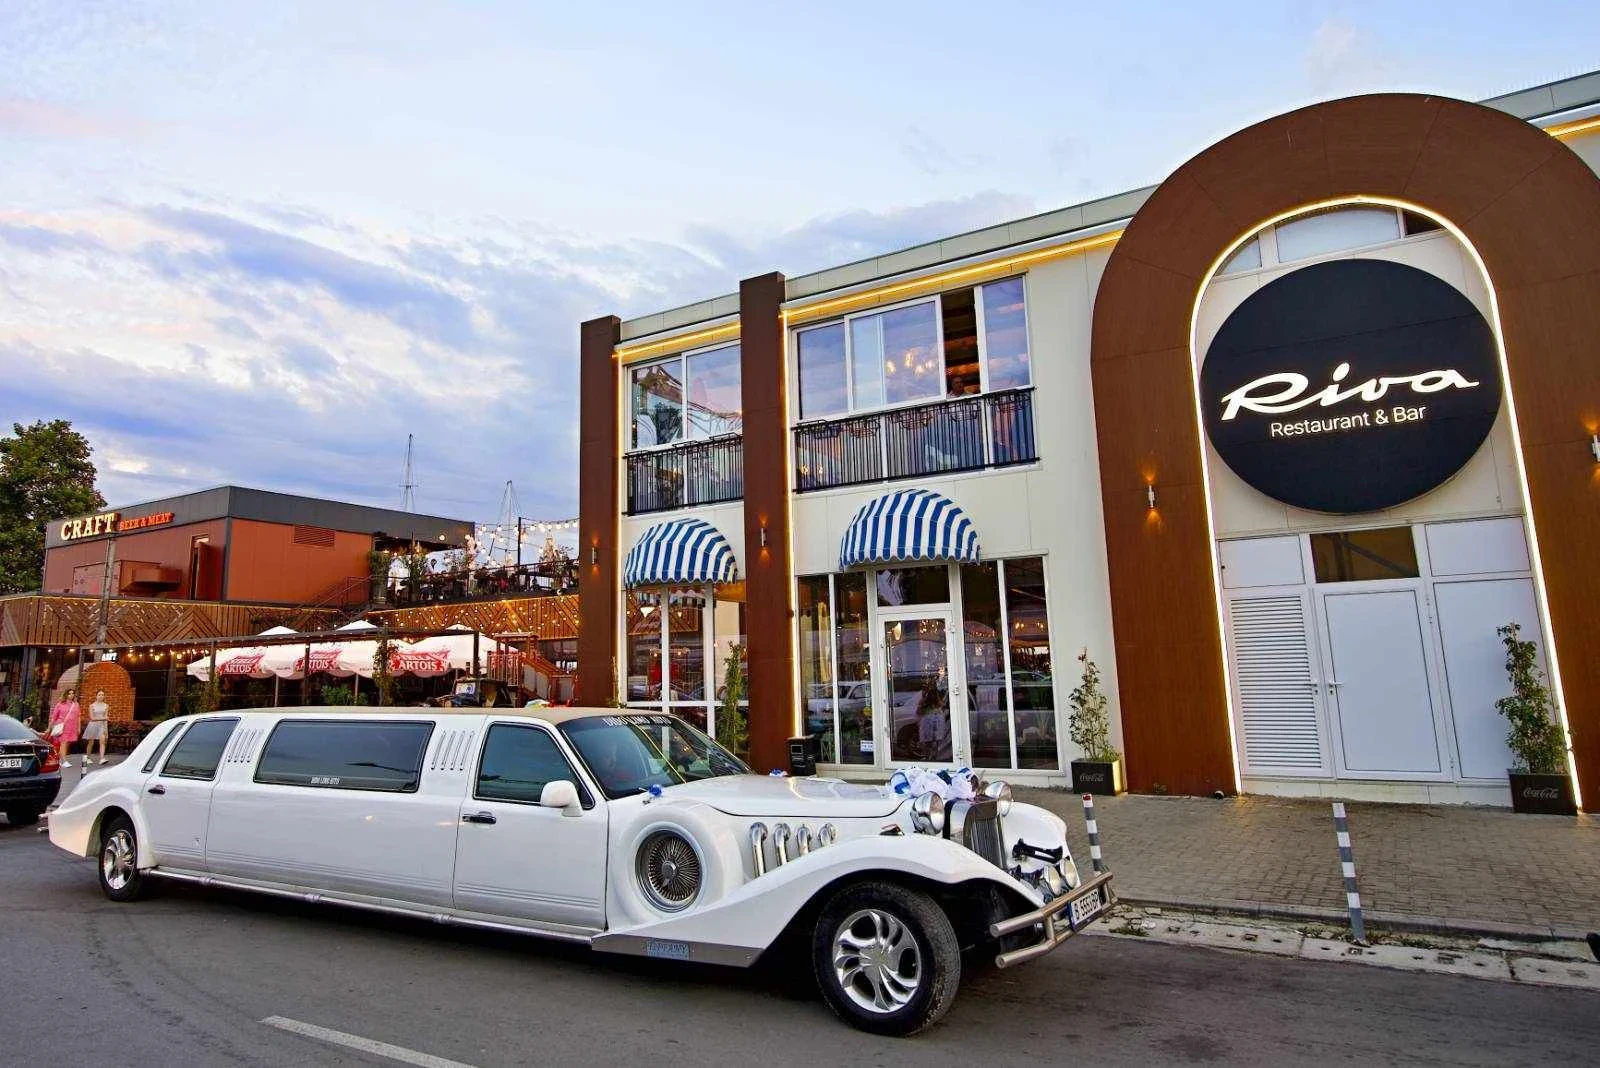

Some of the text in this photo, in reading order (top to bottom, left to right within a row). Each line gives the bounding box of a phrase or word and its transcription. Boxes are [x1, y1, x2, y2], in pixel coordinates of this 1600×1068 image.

[1221, 362, 1480, 421] Riva
[1270, 404, 1428, 438] Restaurant & Bar
[60, 513, 115, 541] CRAFT
[148, 511, 173, 527] MEAT
[399, 660, 438, 671] ARTOIS
